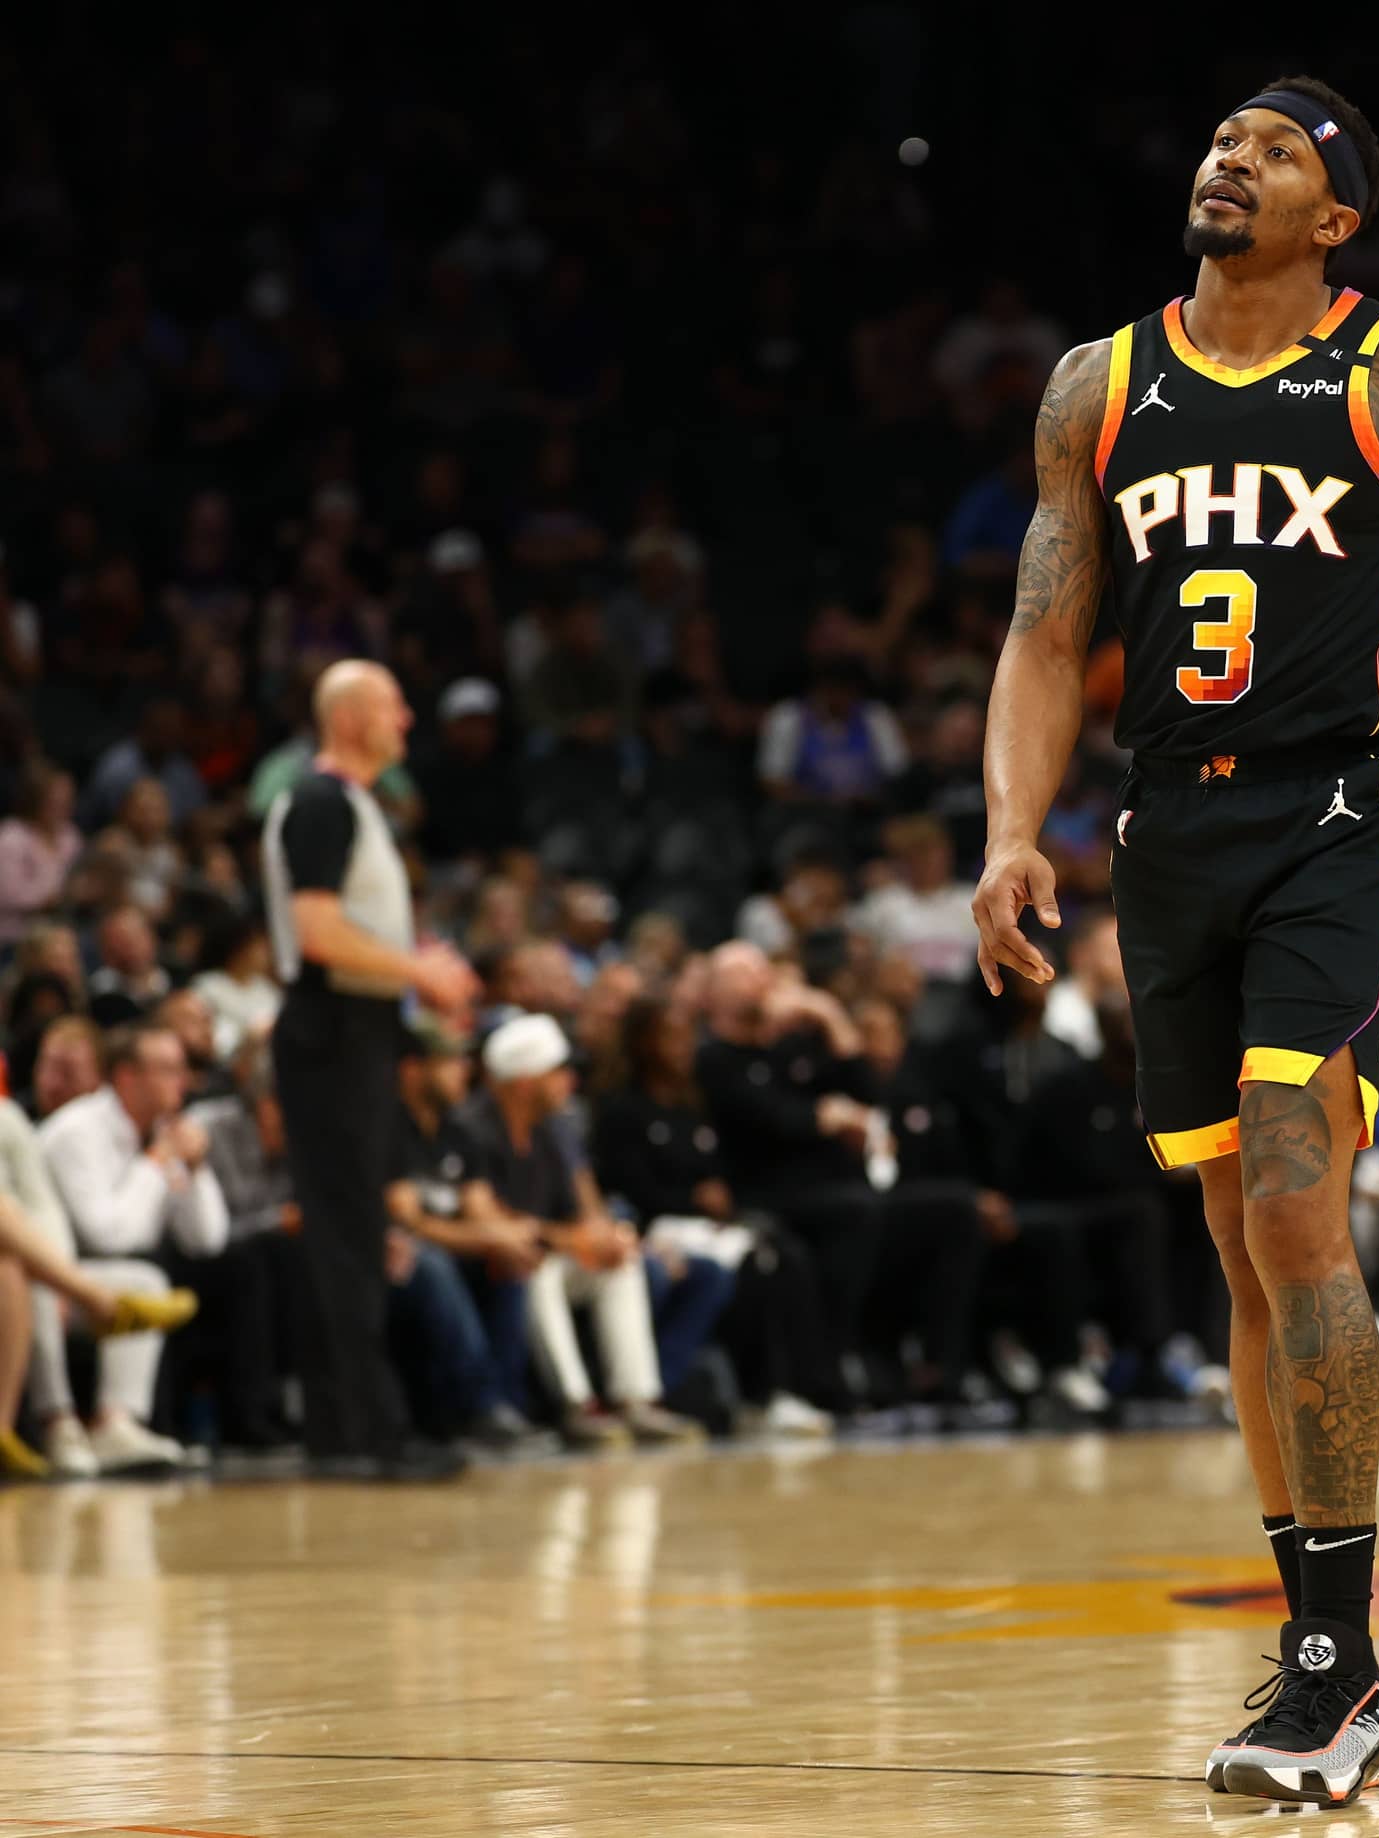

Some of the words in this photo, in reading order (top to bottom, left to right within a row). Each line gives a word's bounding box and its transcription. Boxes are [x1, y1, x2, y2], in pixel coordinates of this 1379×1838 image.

[1277, 378, 1344, 400] PayPal
[1113, 462, 1355, 564] PHX
[1176, 569, 1258, 705] 3
